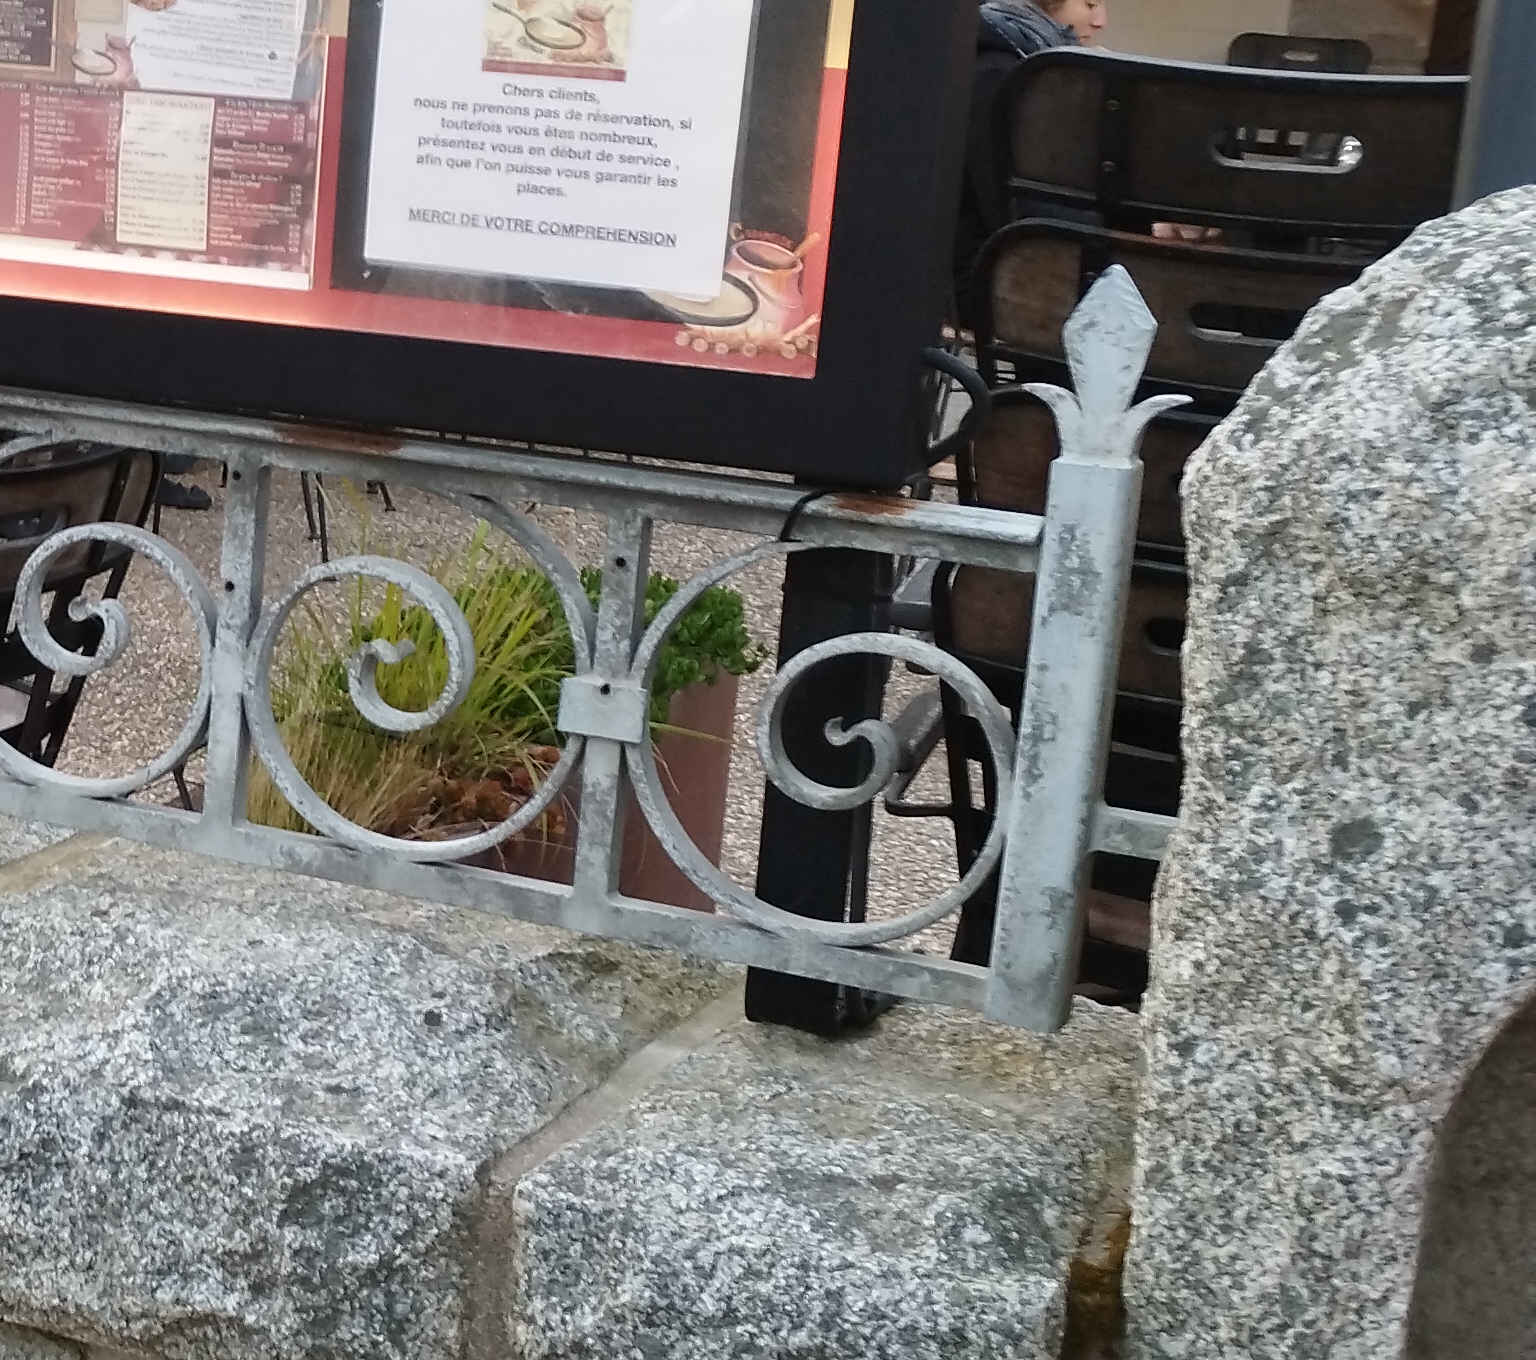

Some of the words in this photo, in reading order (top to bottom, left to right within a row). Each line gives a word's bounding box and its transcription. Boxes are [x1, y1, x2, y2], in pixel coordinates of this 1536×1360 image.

[502, 82, 544, 100] Chers
[548, 86, 600, 105] clients,
[413, 97, 447, 111] nous
[452, 101, 468, 112] ne
[472, 102, 530, 117] prenons
[534, 107, 560, 120] pas
[565, 107, 583, 121] de
[587, 110, 674, 131] réservation,
[680, 118, 693, 130] si
[441, 118, 502, 134] toutefois
[507, 125, 540, 137] vous
[544, 124, 575, 139] êtes
[579, 130, 658, 149] nombreux,
[417, 135, 485, 151] présentez
[491, 142, 524, 155] vous
[528, 145, 546, 157] en
[595, 149, 614, 163] de
[617, 151, 671, 167] service
[416, 153, 442, 167] afin
[446, 158, 471, 170] que
[476, 158, 502, 172] l'on
[505, 161, 552, 177] puisse
[556, 168, 590, 180] vous
[594, 169, 652, 186] garantir
[657, 174, 678, 188] les
[516, 181, 567, 198] places.
[409, 206, 456, 223] MERCI
[460, 212, 479, 227] DE
[484, 214, 534, 233] VOTRE
[537, 220, 677, 247] COMPREHENSION
